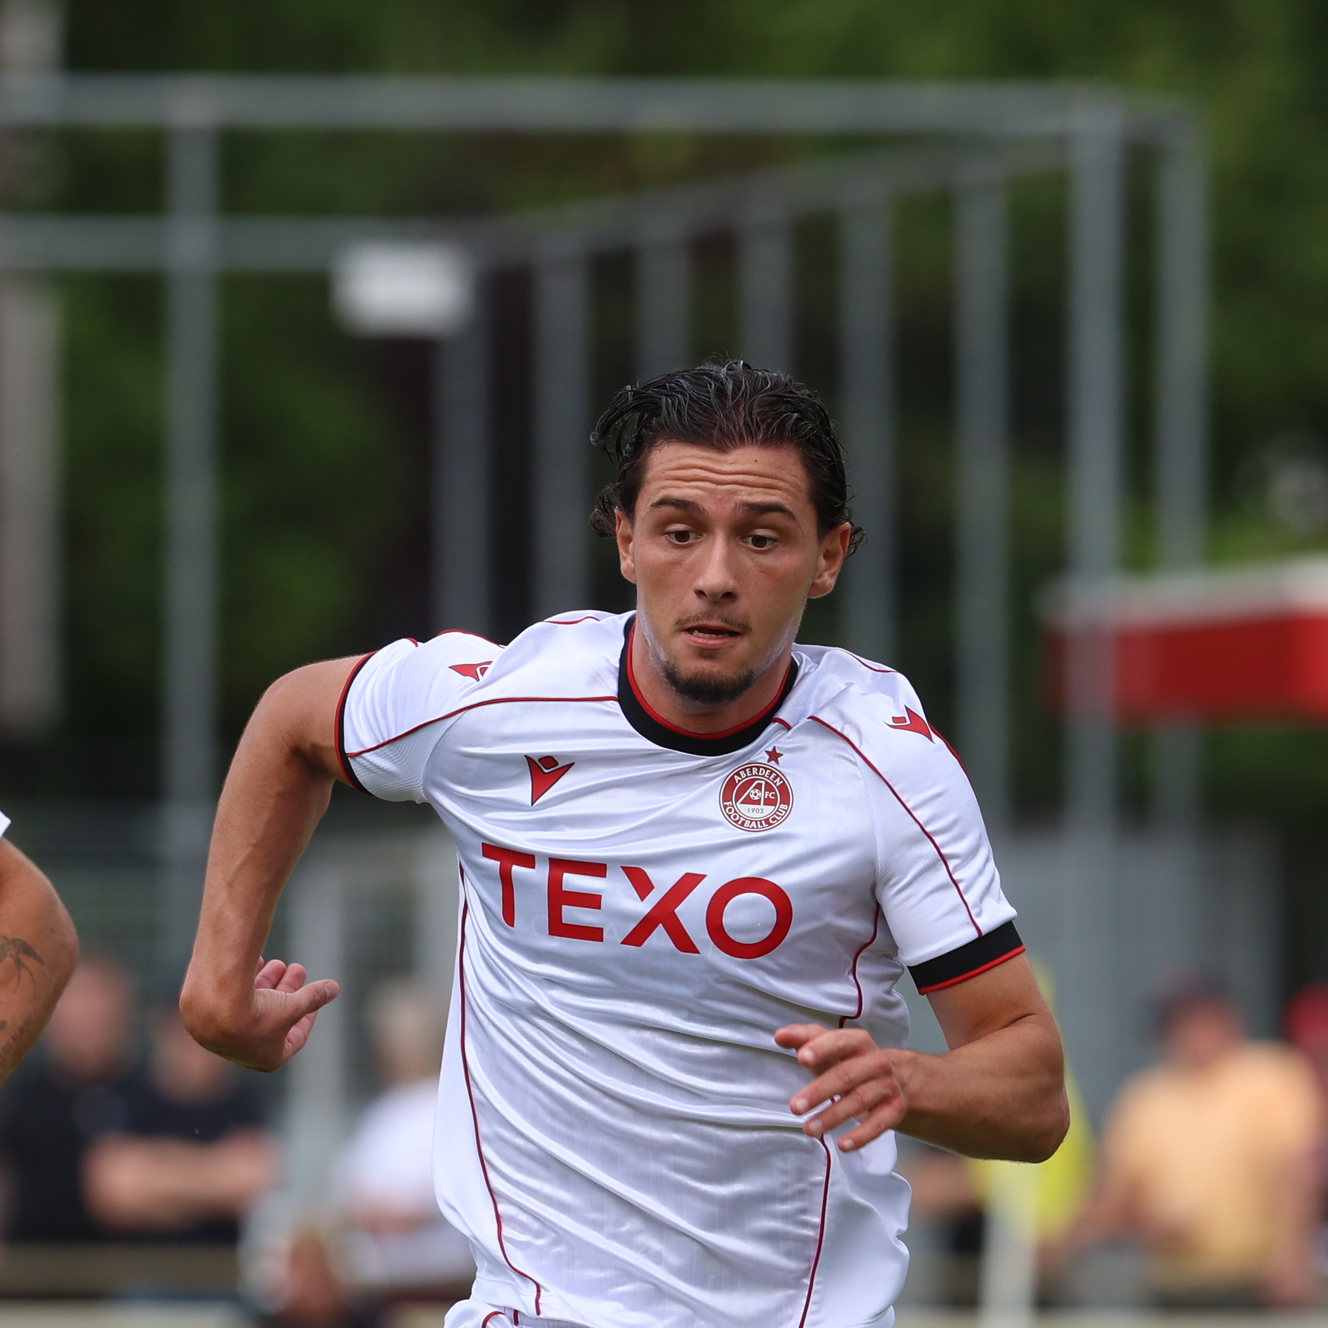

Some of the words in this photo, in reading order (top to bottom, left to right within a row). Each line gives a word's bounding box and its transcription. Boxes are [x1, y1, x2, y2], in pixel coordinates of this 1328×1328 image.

[733, 767, 784, 787] ABERDEEN
[723, 801, 769, 829] FOOTBALL
[768, 803, 789, 824] CLUB
[747, 807, 764, 815] 1903
[481, 841, 794, 960] TEXO
